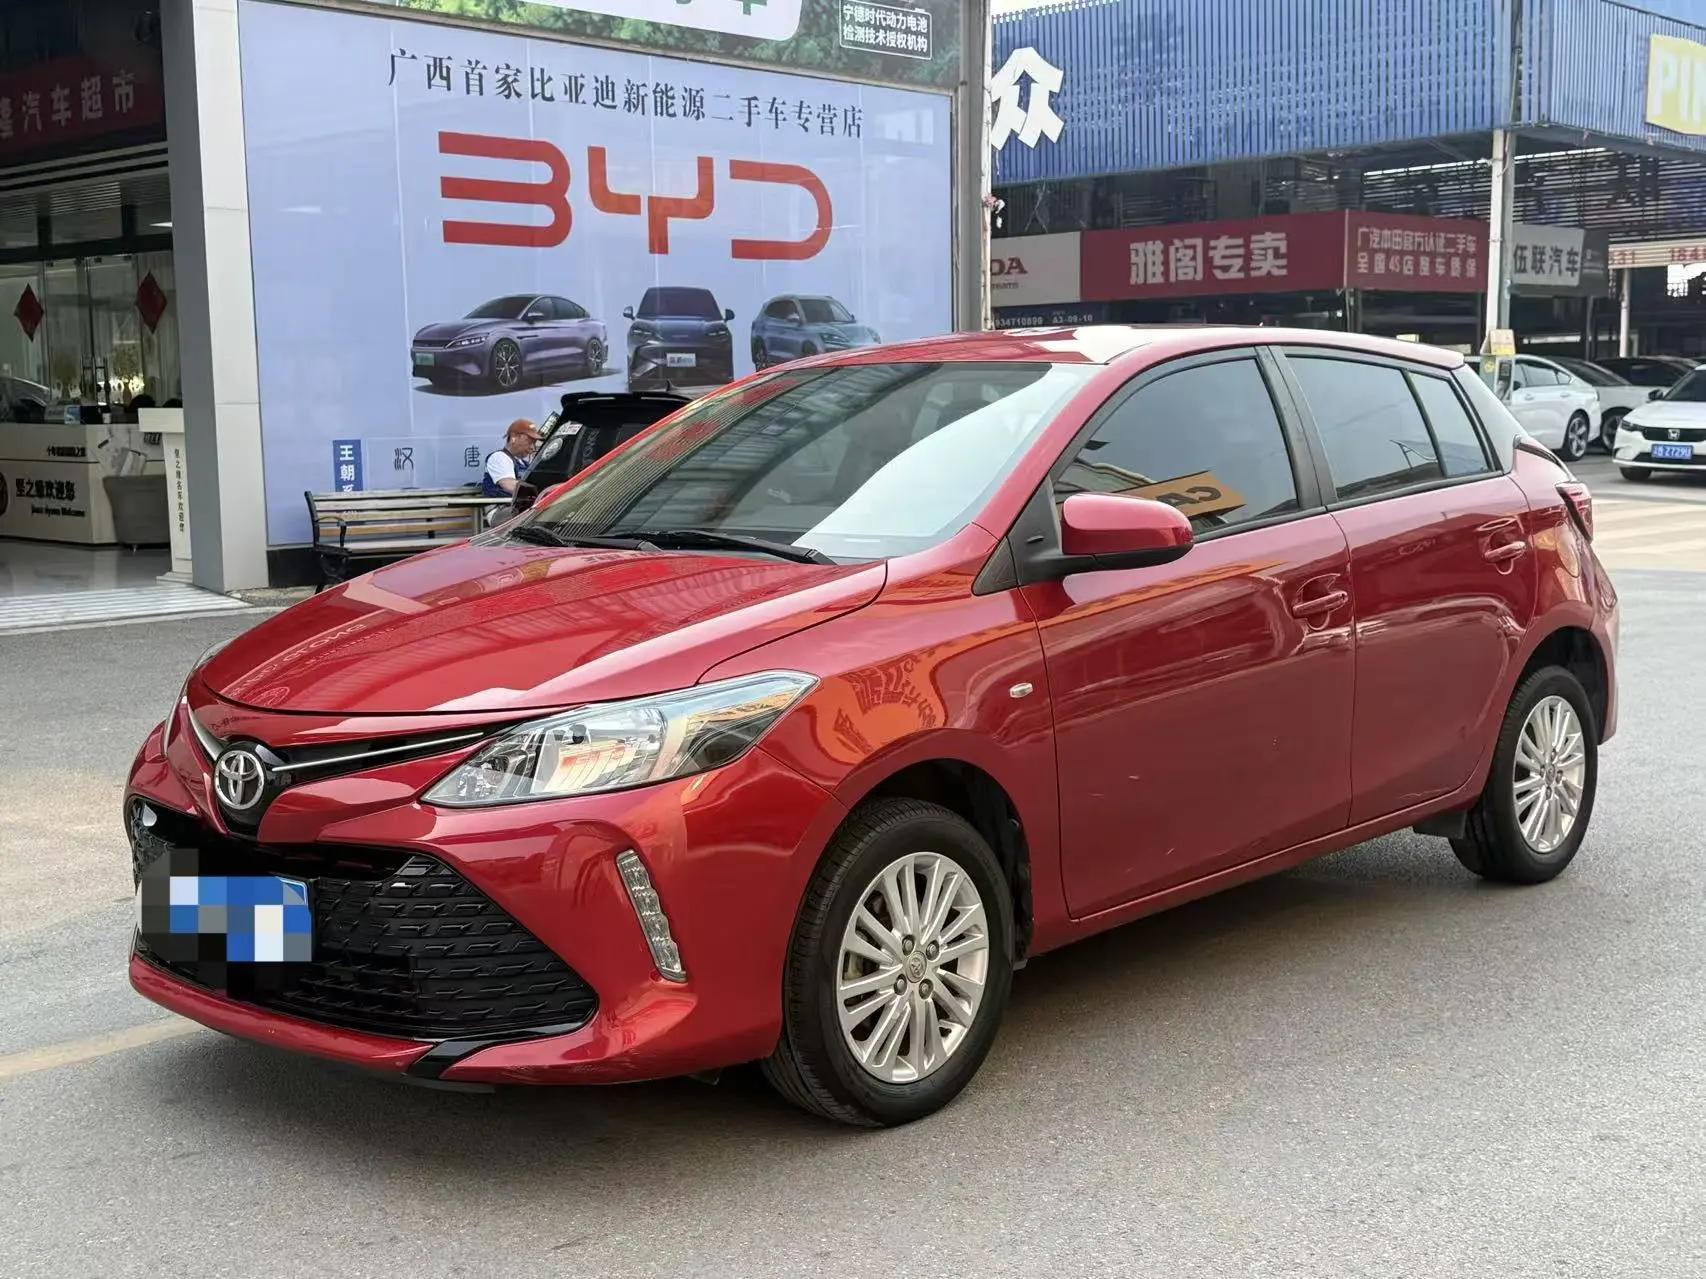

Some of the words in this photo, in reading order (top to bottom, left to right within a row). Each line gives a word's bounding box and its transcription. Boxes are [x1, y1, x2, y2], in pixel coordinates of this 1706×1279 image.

[843, 4, 927, 33] 宁德时代动力电池
[843, 23, 927, 53] 检测技术授权机构
[388, 48, 862, 138] 广西首家比亚迪新能源二手车专营店
[991, 46, 1064, 151] 众
[438, 131, 832, 261] BYD
[1130, 231, 1287, 285] 雅阁专卖
[1513, 244, 1579, 278] 伍联汽车
[464, 445, 480, 468] 唐
